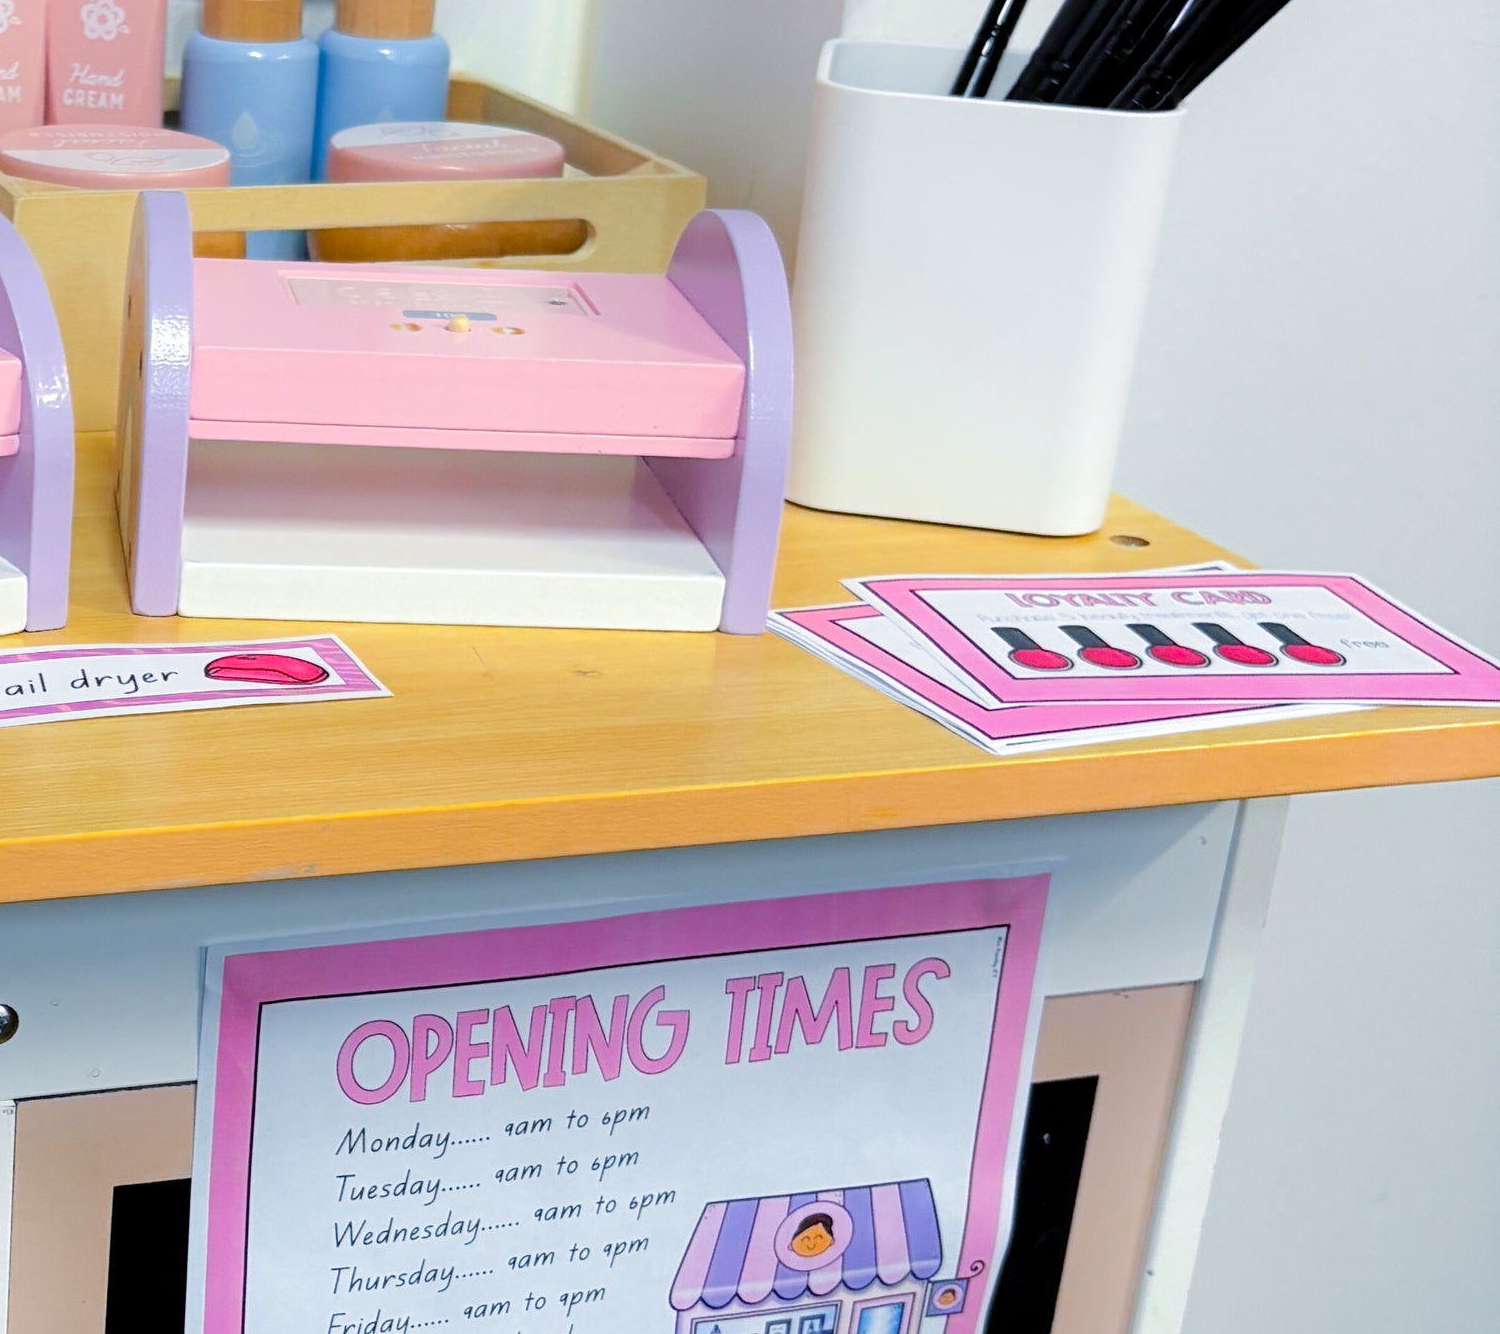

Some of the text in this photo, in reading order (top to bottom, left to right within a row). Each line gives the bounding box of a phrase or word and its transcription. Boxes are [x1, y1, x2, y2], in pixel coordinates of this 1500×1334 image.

[70, 63, 125, 87] Hand
[63, 88, 124, 109] CREAM
[1004, 589, 1273, 610] LOYALTY CARD
[1340, 637, 1390, 651] free
[70, 667, 180, 696] dryer
[336, 957, 951, 1105] OPENING TIMES
[504, 1116, 552, 1137] 9am
[567, 1109, 589, 1129] to
[601, 1106, 650, 1137] 6pm
[494, 1162, 542, 1183] 9am
[556, 1156, 579, 1176] to
[591, 1151, 639, 1182] 6pm
[534, 1202, 582, 1223] 9am
[596, 1195, 617, 1215] to
[628, 1189, 676, 1220] 6pm
[507, 1249, 555, 1271] 9am
[569, 1242, 590, 1263] to
[603, 1237, 650, 1268] 9pm
[463, 1299, 511, 1320] 9am
[524, 1292, 547, 1312] to
[559, 1287, 606, 1317] 9pm
